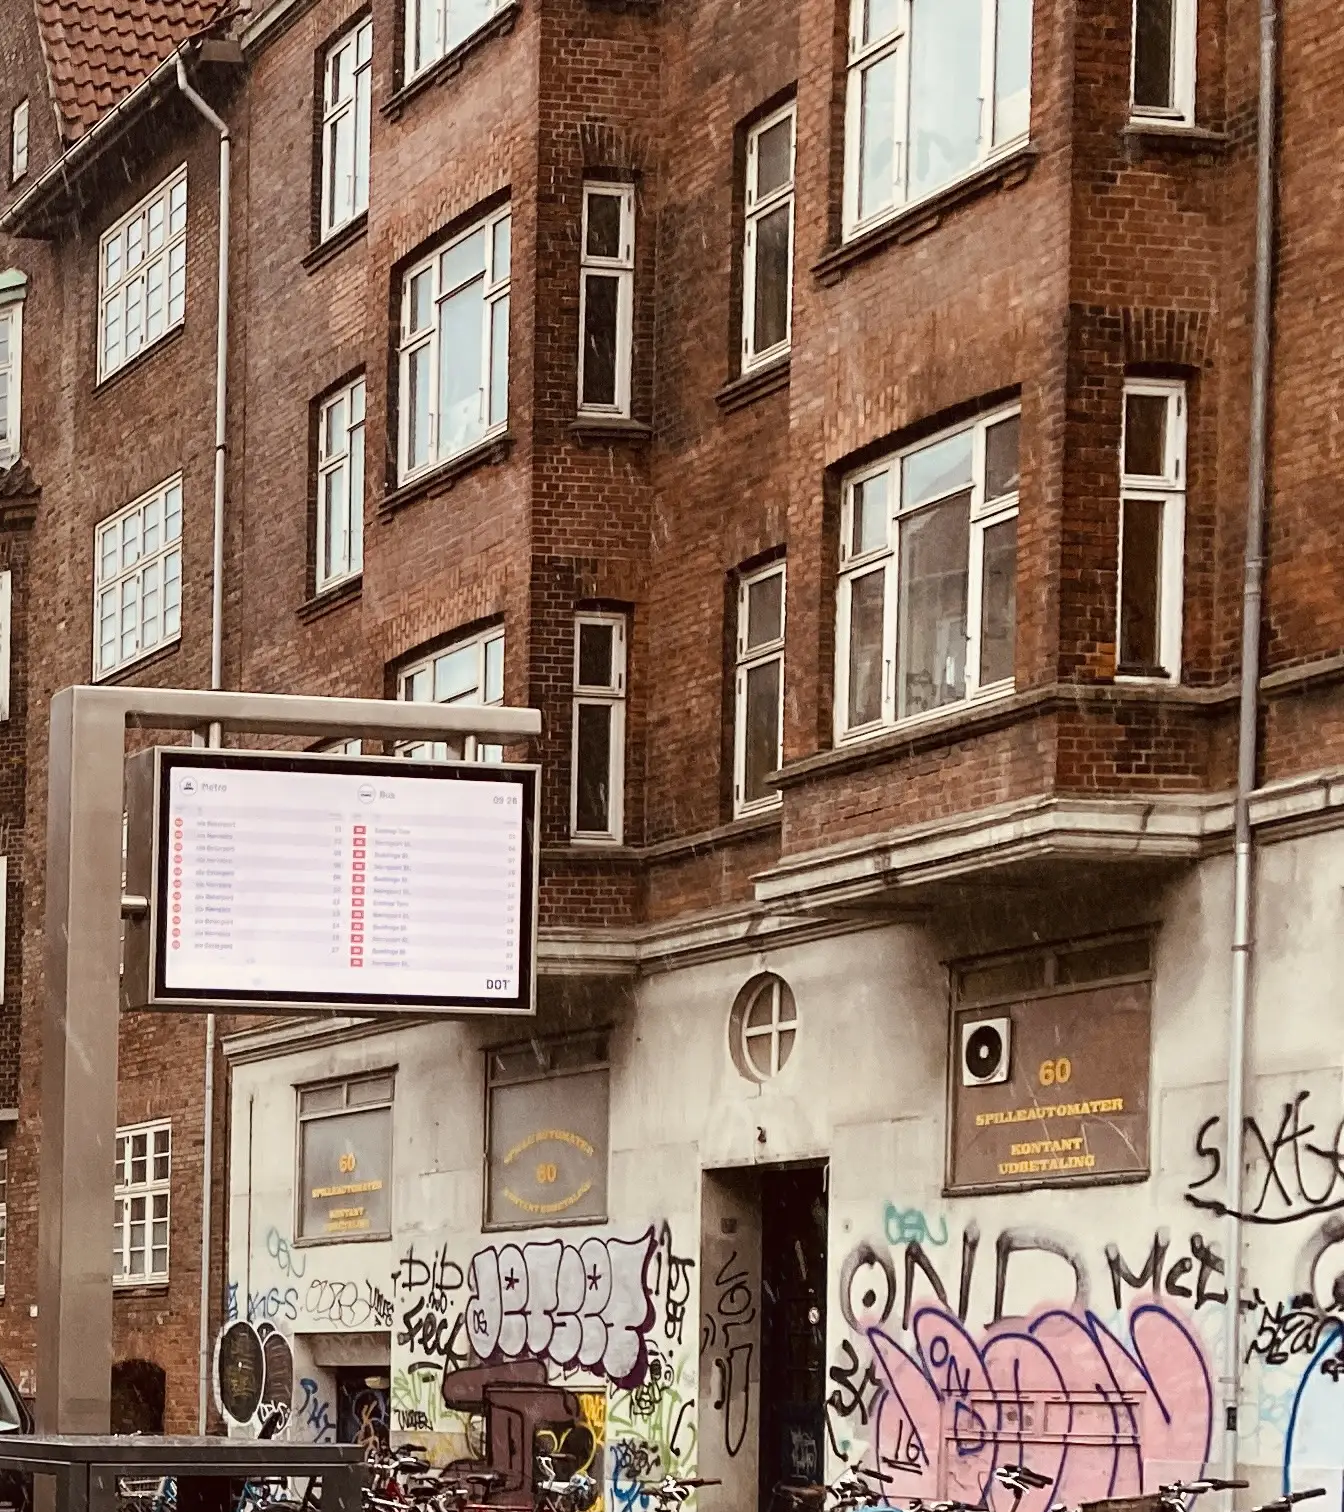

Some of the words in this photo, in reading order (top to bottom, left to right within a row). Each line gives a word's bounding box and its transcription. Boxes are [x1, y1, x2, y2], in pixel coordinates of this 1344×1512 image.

[201, 783, 227, 792] Metro
[380, 791, 395, 799] Bus
[486, 979, 509, 990] DOT
[1038, 1057, 1072, 1086] 60
[975, 1098, 1124, 1126] SPILLEAUTOMATER
[1011, 1138, 1083, 1155] KONTANT
[339, 1152, 356, 1173] 60
[999, 1155, 1095, 1174] UDBETALING
